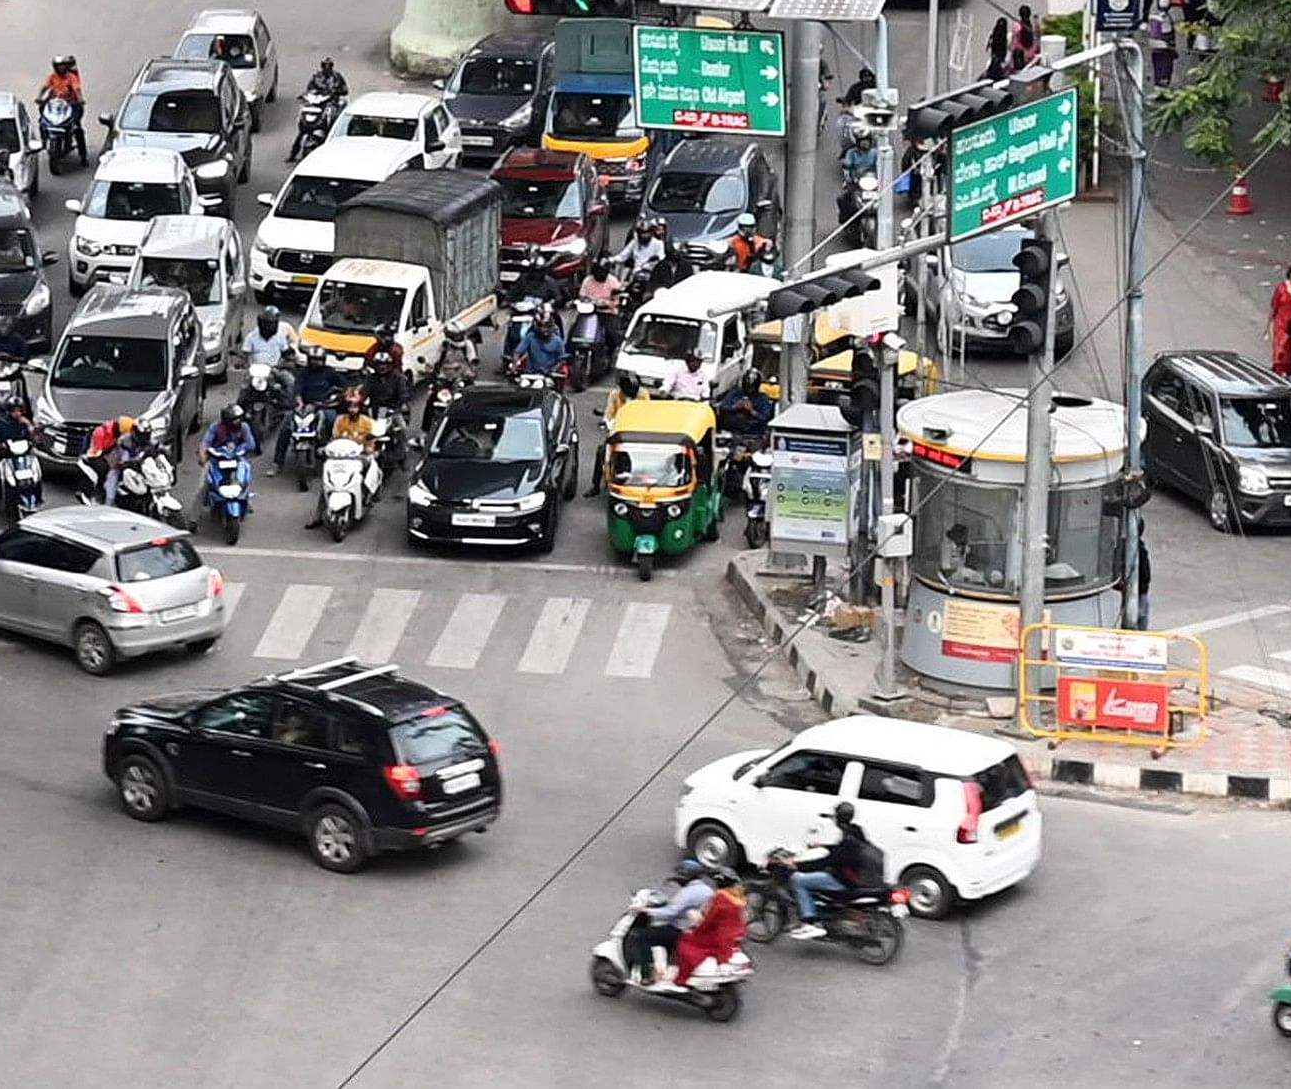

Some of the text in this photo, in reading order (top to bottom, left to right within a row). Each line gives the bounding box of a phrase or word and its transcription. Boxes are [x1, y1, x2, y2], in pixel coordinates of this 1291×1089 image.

[727, 35, 748, 53] Road
[702, 86, 745, 108] Old Airport
